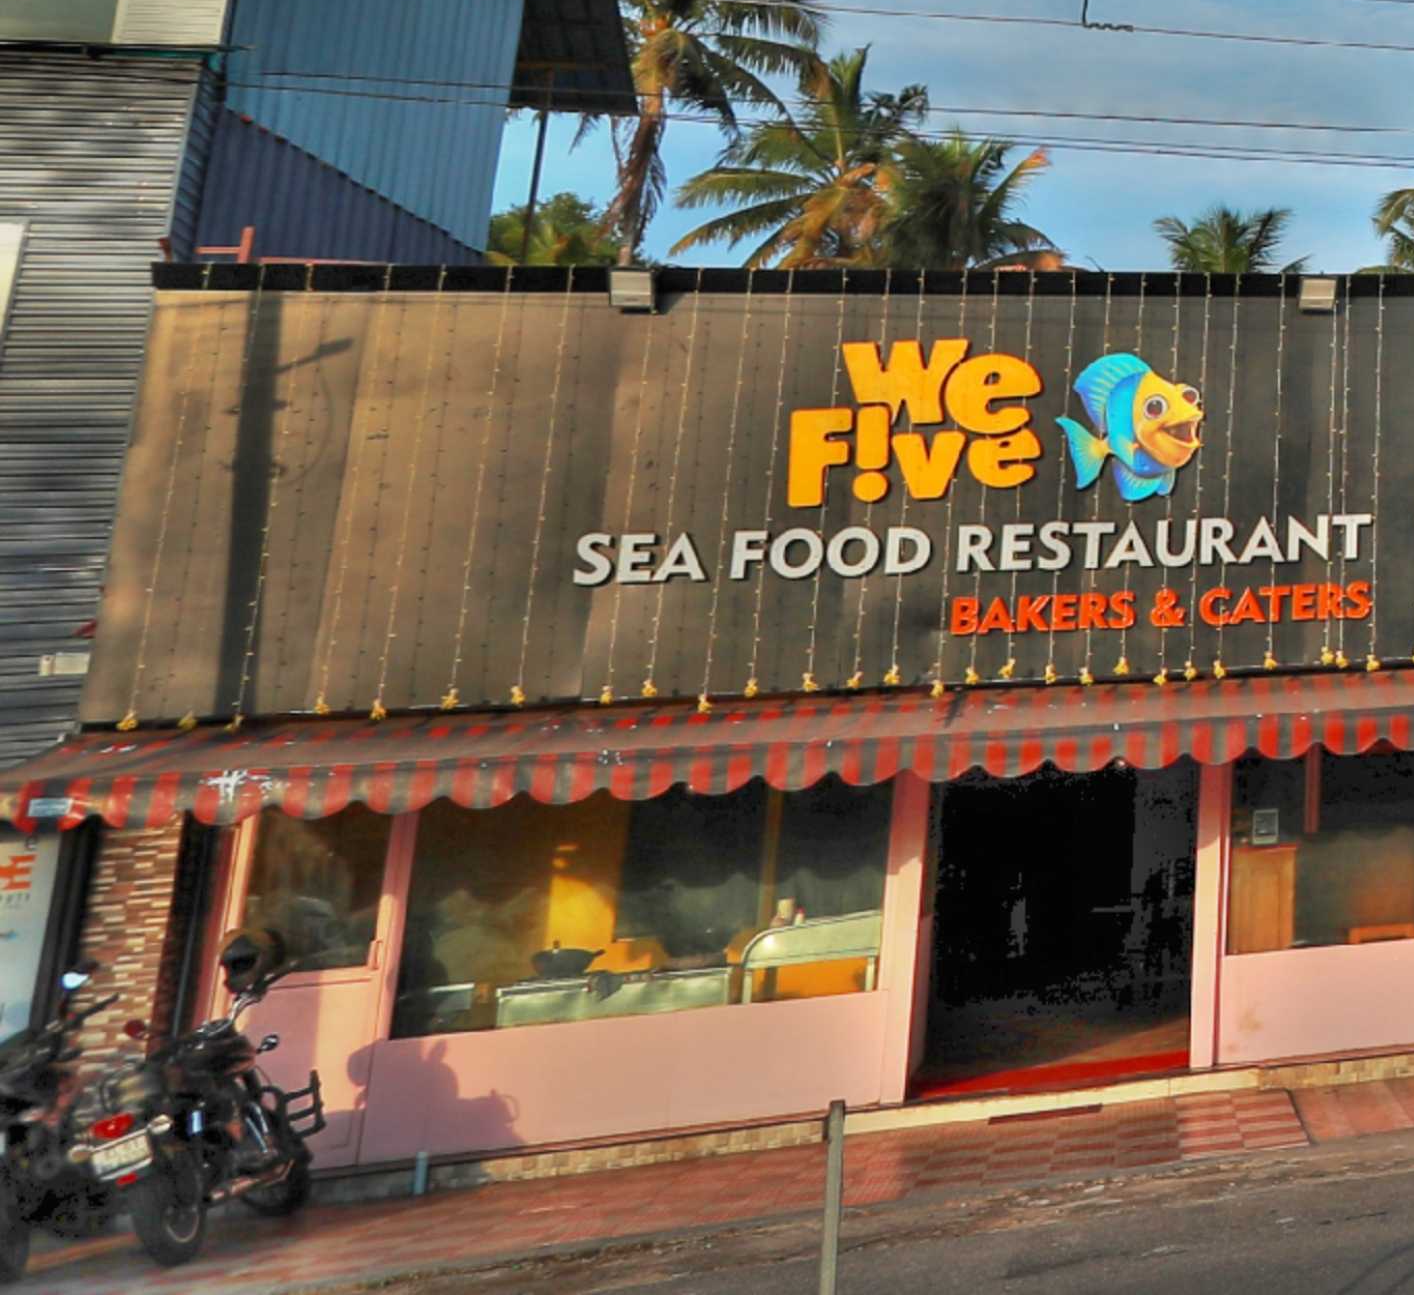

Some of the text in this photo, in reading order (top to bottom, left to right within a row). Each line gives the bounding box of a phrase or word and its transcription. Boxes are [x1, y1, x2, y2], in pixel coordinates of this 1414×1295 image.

[842, 338, 1043, 434] We
[572, 514, 1374, 586] SEA FOOD RESTAURANT
[949, 581, 1374, 635] BAKERS & CATERS
